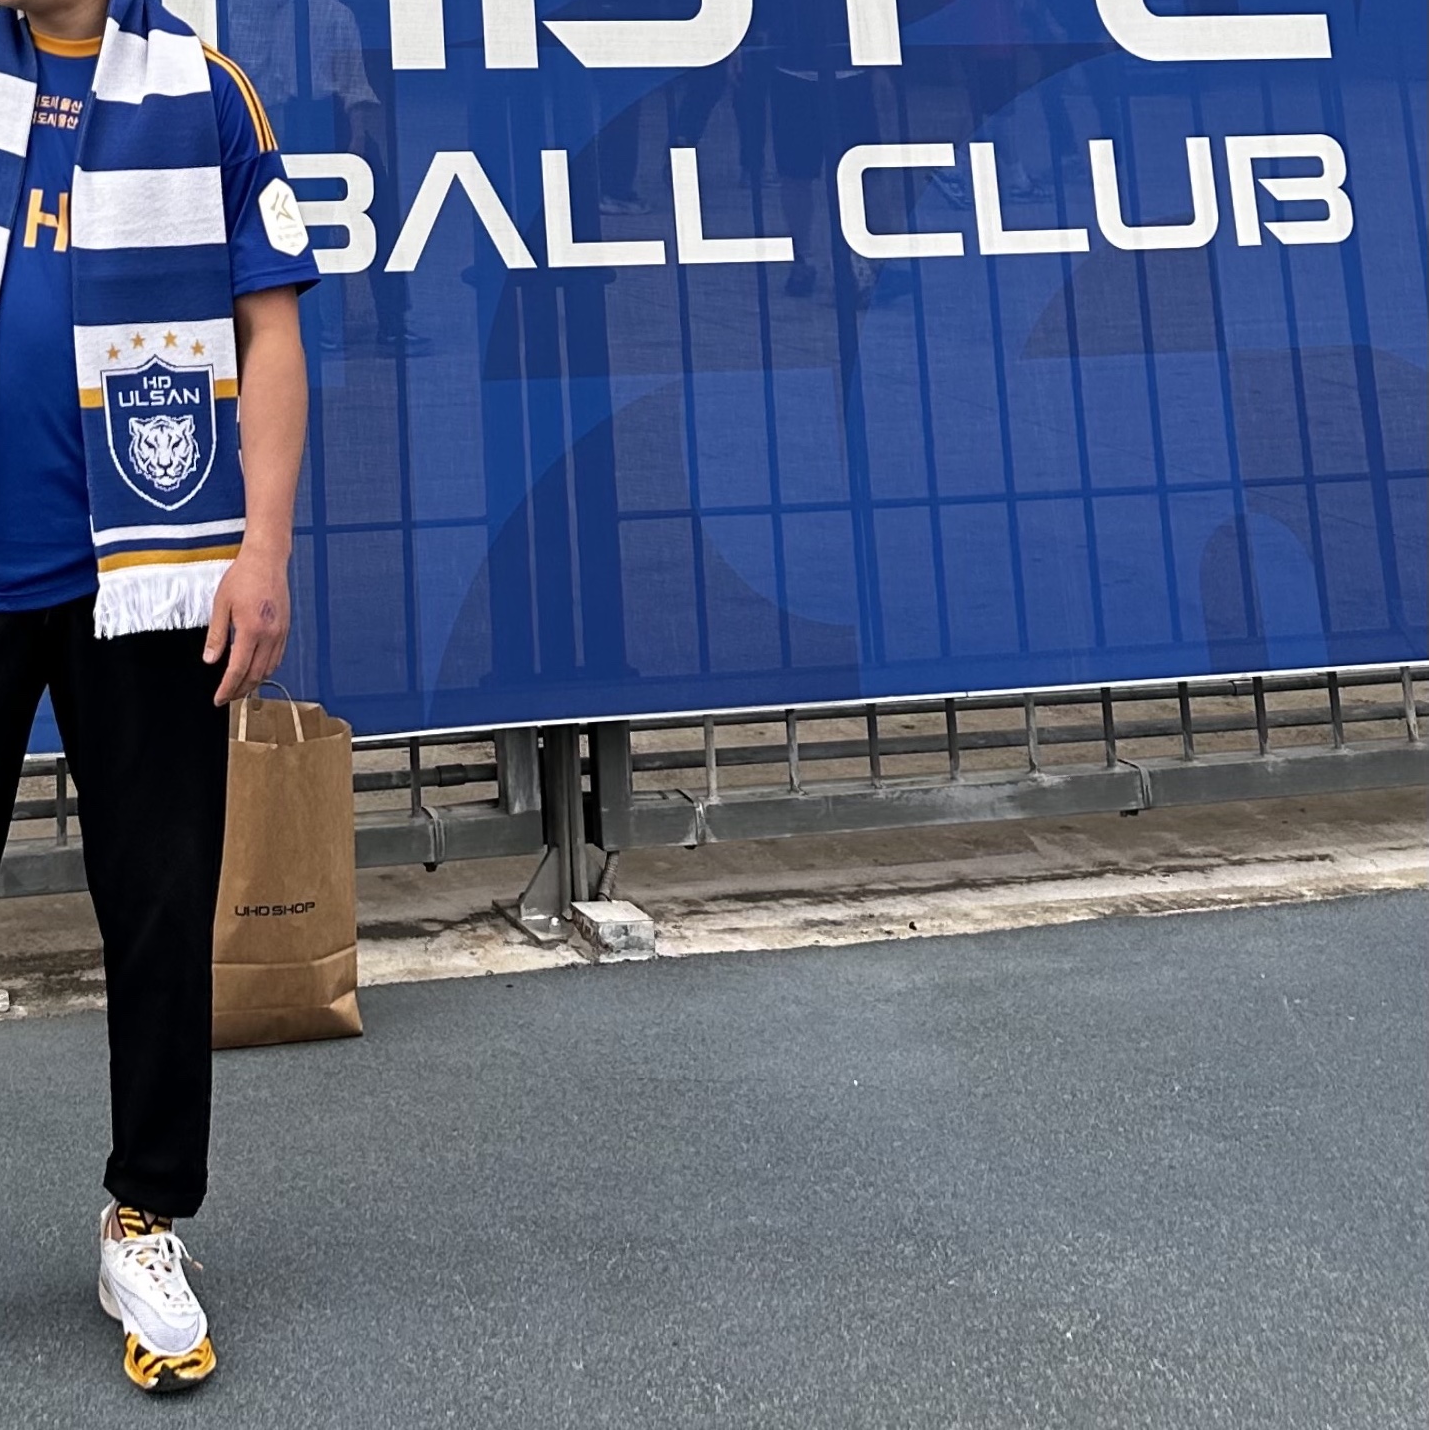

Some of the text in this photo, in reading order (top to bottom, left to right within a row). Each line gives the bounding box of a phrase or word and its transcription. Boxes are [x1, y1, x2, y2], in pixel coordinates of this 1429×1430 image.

[836, 133, 1354, 259] CLUB
[143, 376, 172, 389] HD
[118, 388, 200, 407] ULSAN
[272, 901, 315, 916] SHOP
